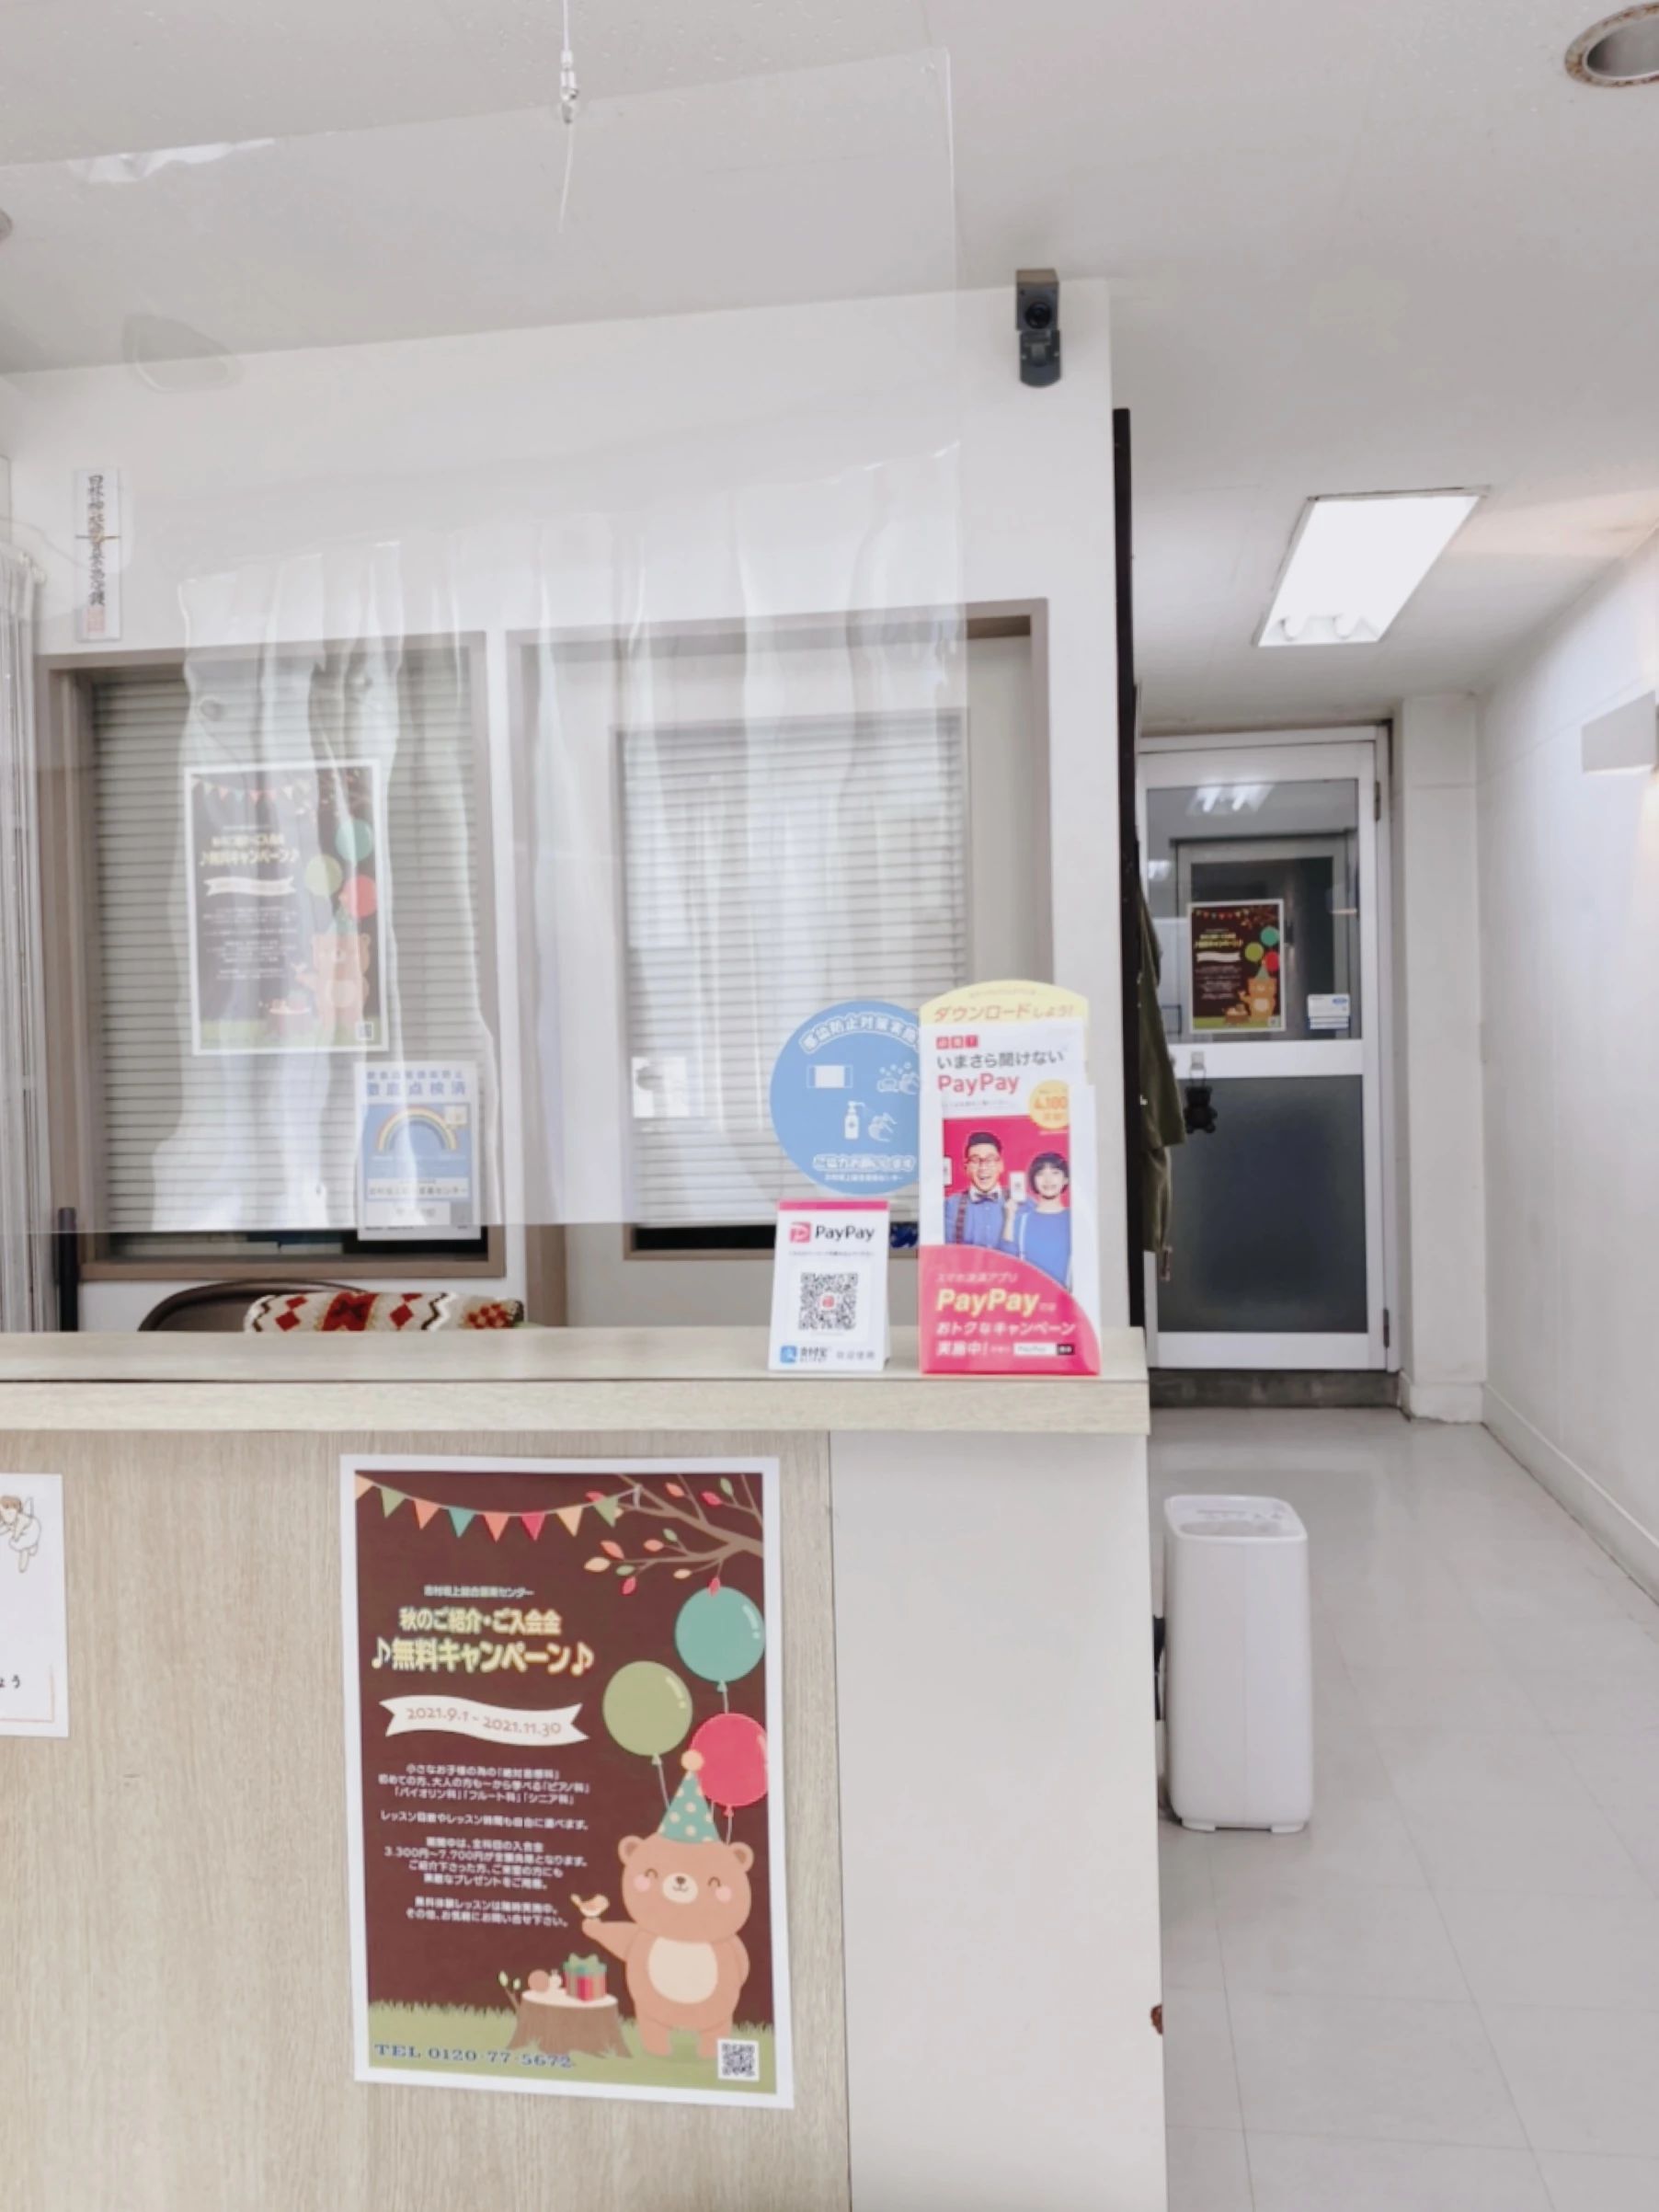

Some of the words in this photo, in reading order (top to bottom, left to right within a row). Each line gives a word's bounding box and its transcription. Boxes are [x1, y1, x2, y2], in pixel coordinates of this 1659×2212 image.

[936, 1050, 1065, 1070] いまさら聞けない
[937, 1072, 1020, 1096] PayPay
[815, 1224, 875, 1242] PayPay
[934, 1288, 1040, 1318] PayPay
[374, 2044, 421, 2058] TEL
